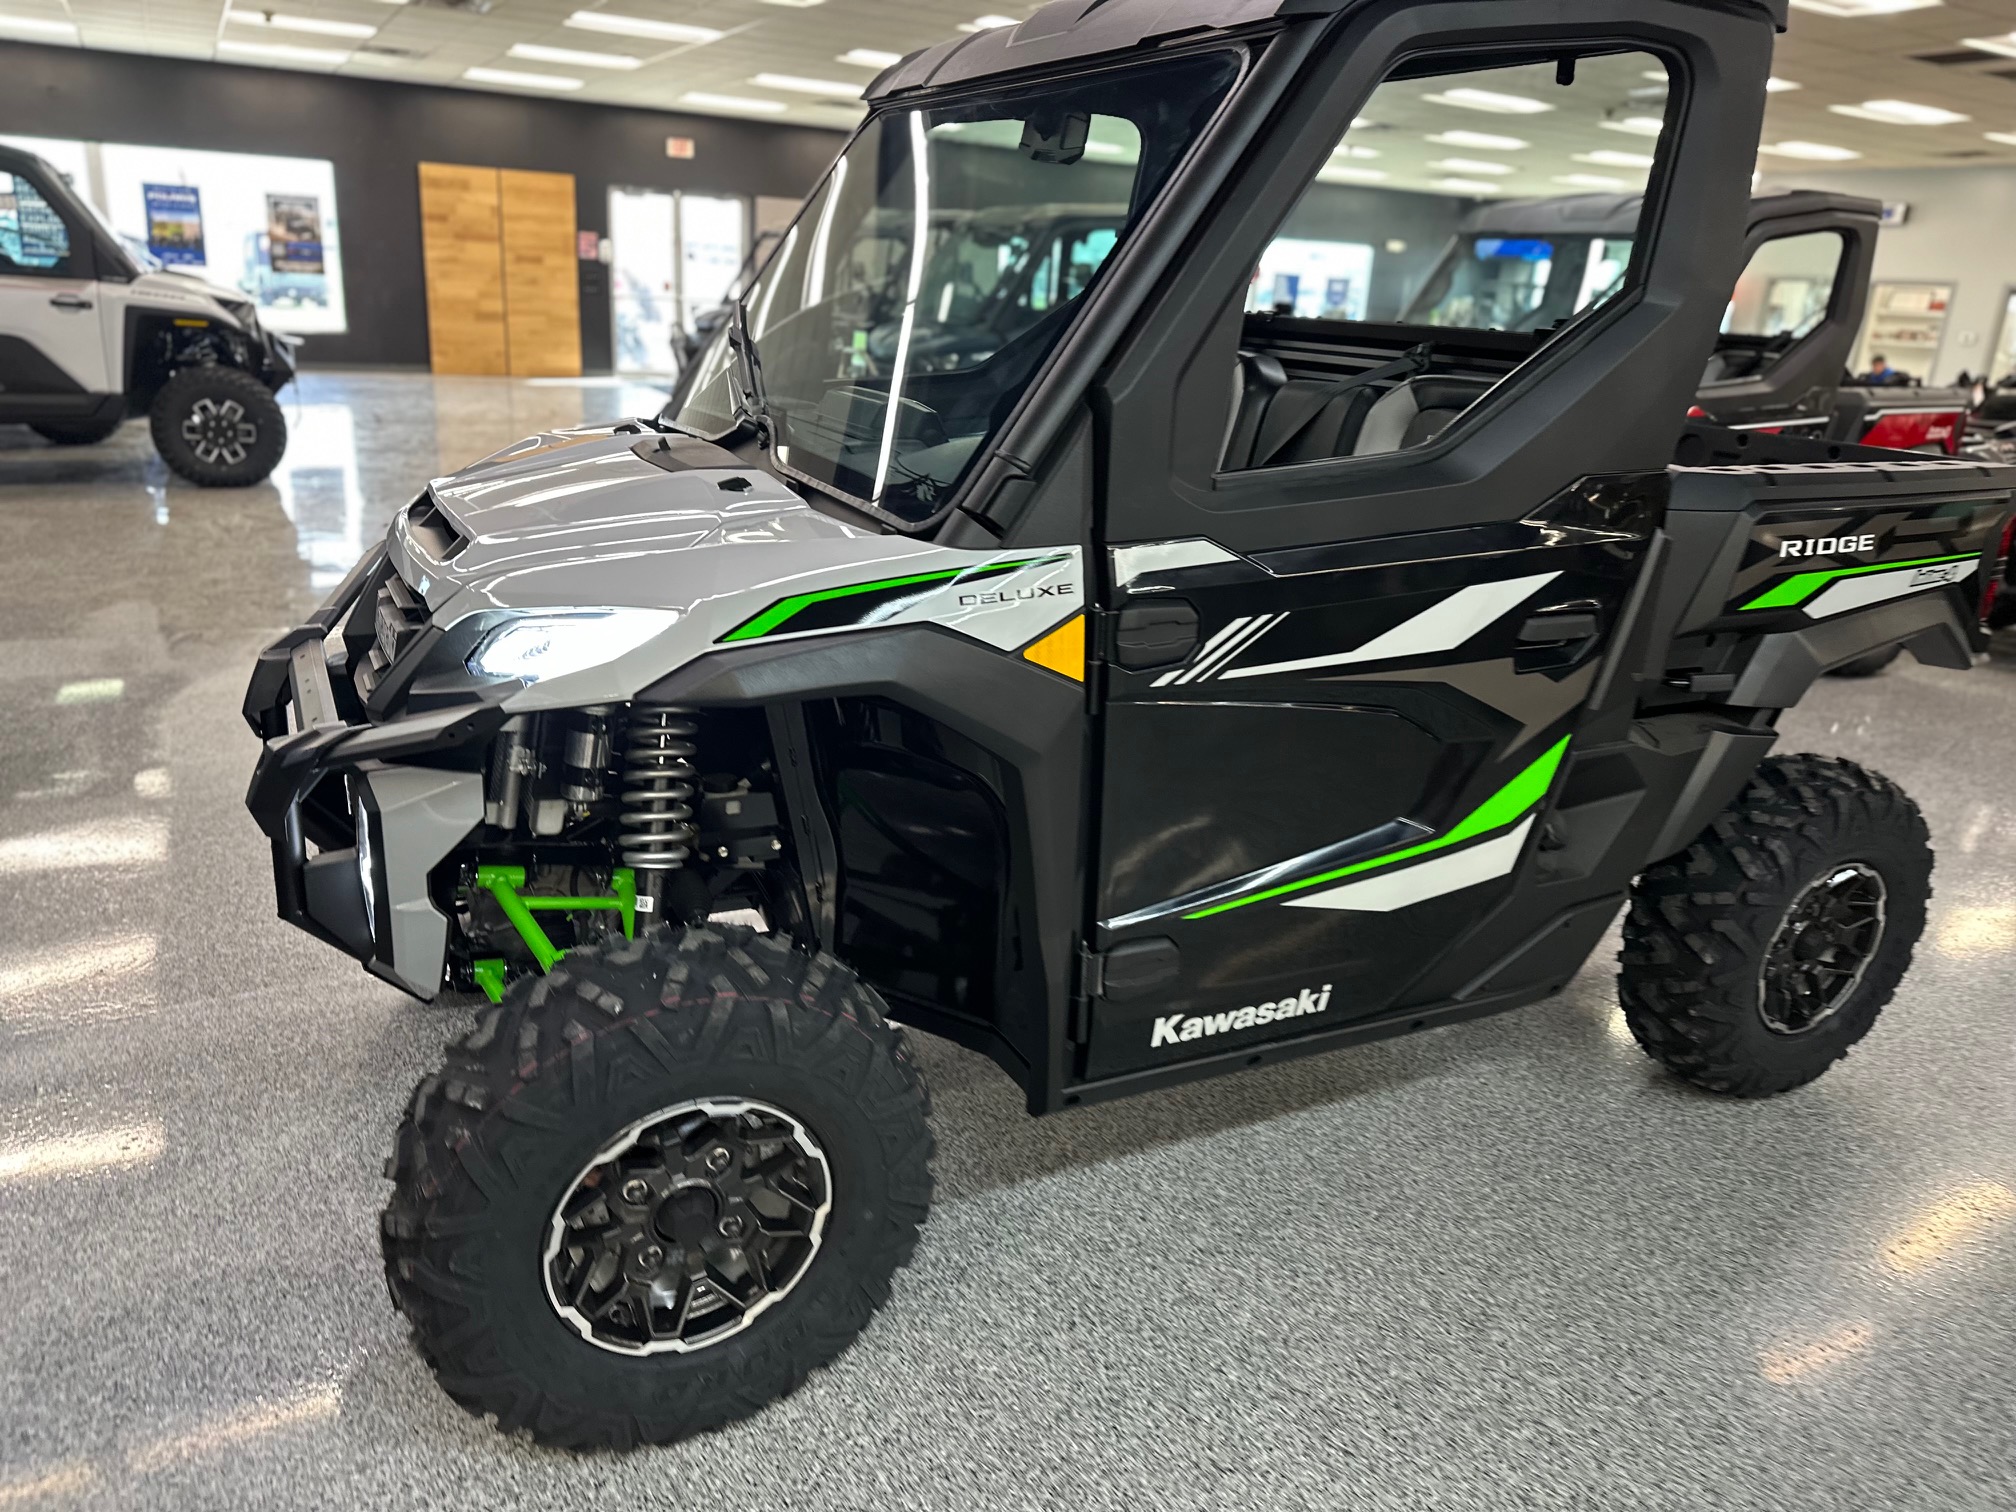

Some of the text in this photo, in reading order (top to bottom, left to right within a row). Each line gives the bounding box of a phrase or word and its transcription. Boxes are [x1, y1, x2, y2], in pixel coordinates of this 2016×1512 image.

[1779, 534, 1875, 558] RIDGE
[959, 583, 1074, 606] DELUXE
[1150, 984, 1333, 1048] Kawasaki
